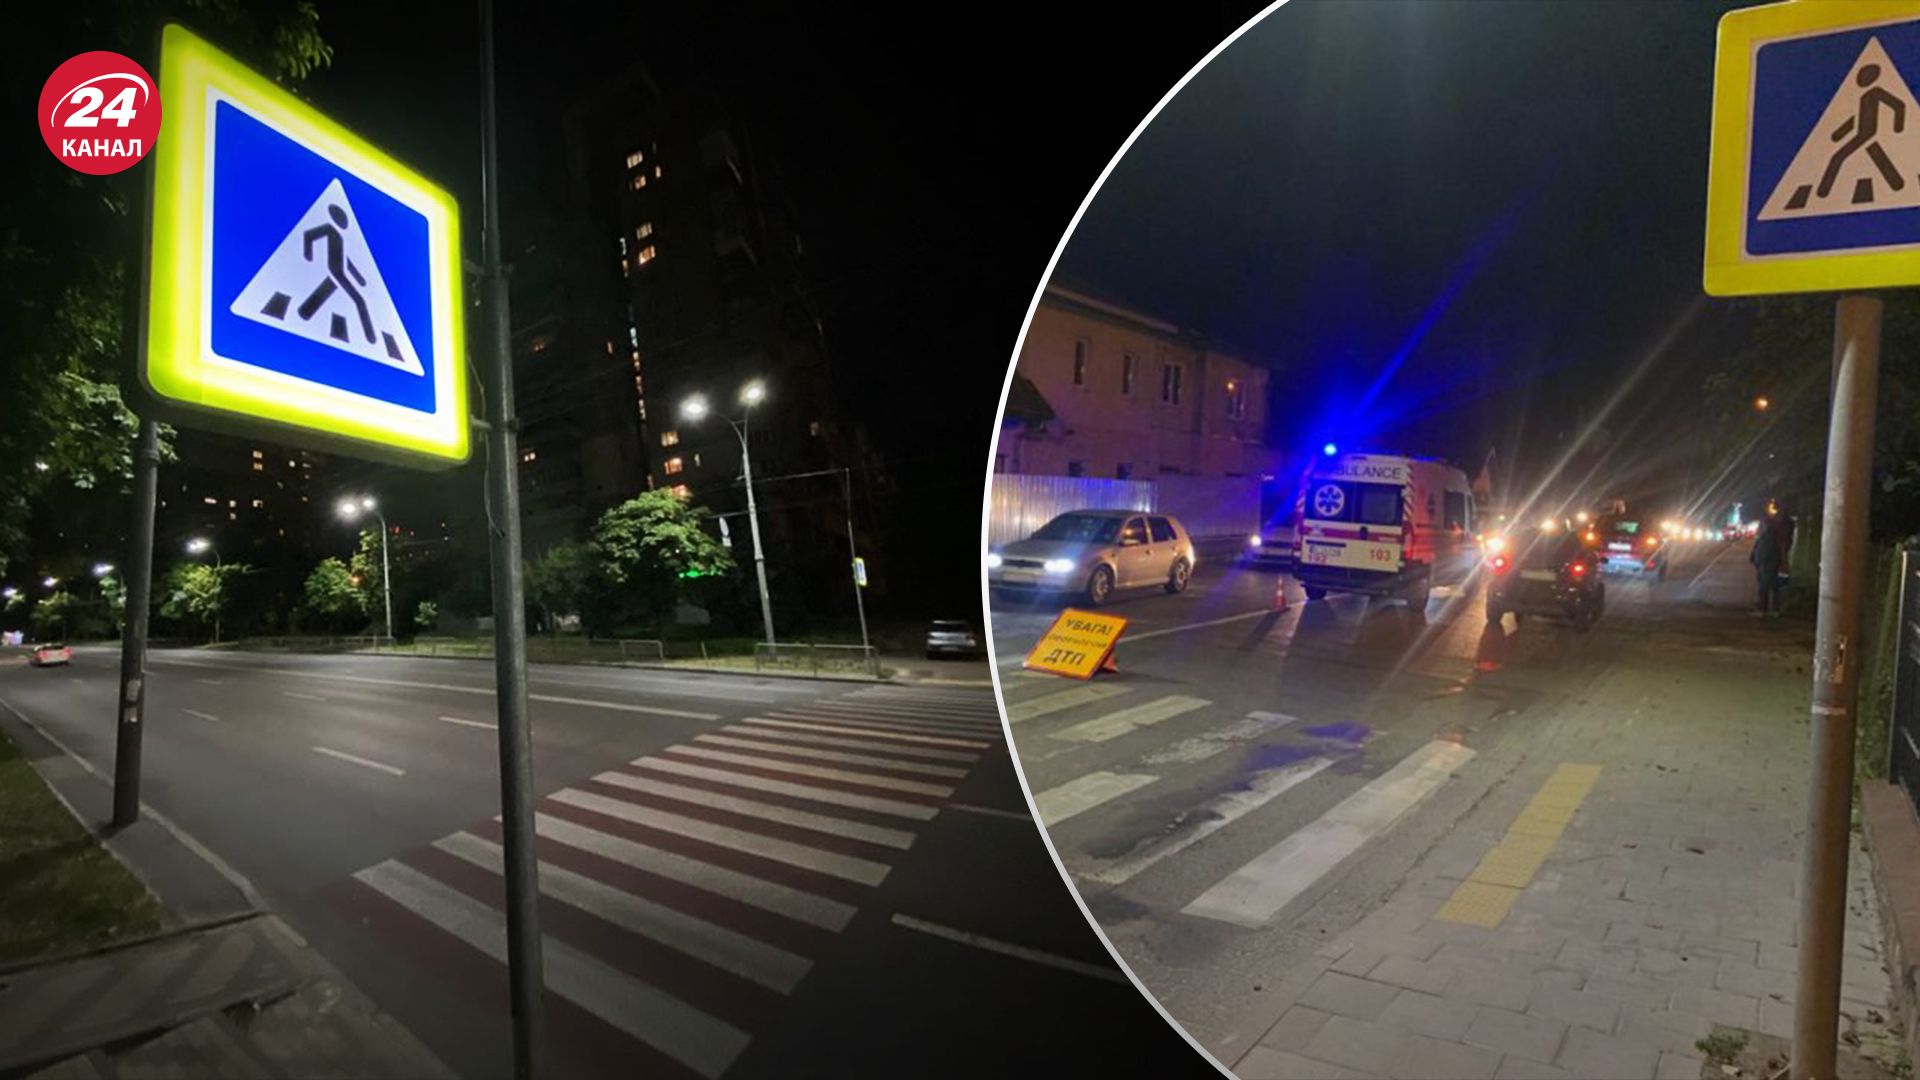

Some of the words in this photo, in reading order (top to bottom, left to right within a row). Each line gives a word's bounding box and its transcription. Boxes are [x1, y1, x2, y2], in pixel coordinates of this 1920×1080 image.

[1335, 465, 1401, 480] BULANCE
[1370, 549, 1390, 562] 103
[1066, 618, 1113, 635] УВАГА!
[1043, 648, 1086, 666] ДТП
